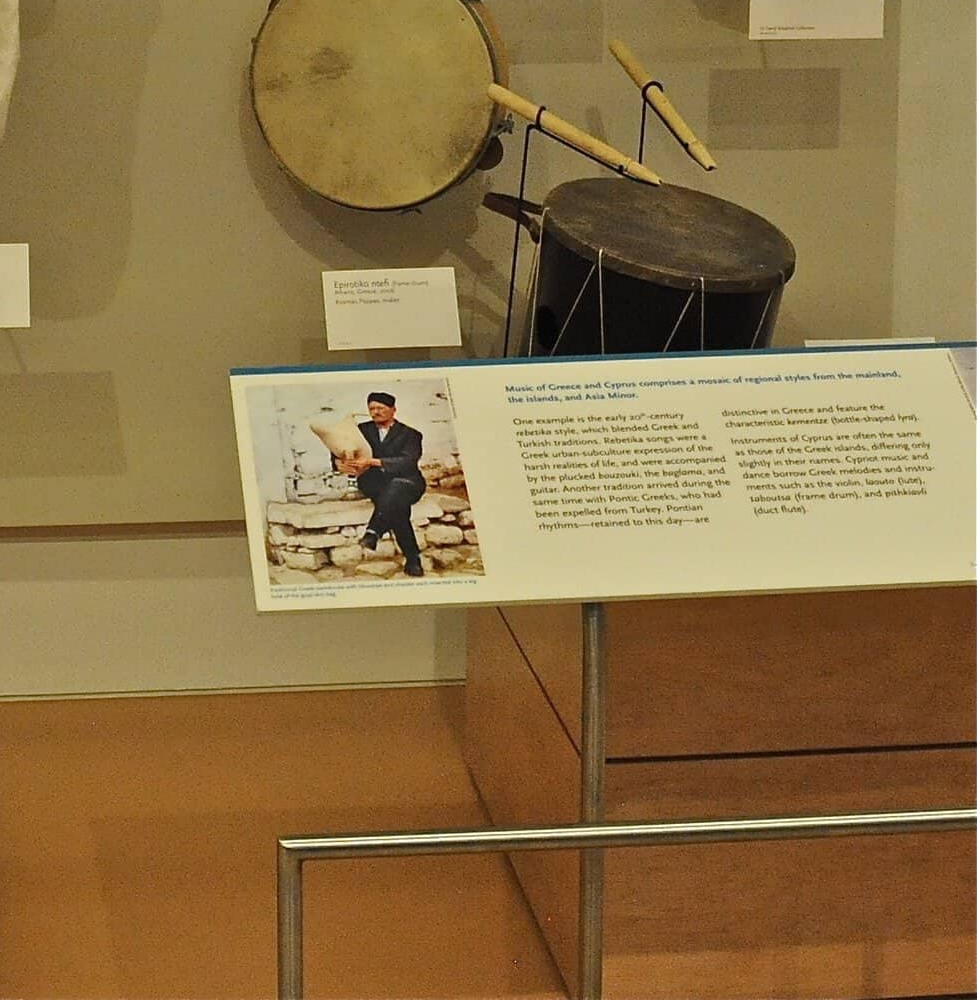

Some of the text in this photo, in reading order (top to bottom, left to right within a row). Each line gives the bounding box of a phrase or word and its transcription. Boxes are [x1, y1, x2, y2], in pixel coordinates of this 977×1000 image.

[505, 384, 533, 392] Music
[536, 383, 545, 391] of
[584, 381, 601, 389] and
[603, 381, 636, 390] Cyprus
[638, 379, 686, 389] comprises
[697, 377, 730, 385] mosaic
[733, 376, 742, 384] of
[744, 375, 782, 385] regional
[784, 374, 810, 384] styles
[812, 373, 835, 381] from
[837, 372, 852, 380] the
[507, 395, 523, 403] the
[565, 393, 582, 401] and
[585, 392, 605, 400] Asia
[721, 408, 767, 416] distinctive
[781, 406, 814, 414] Greece
[835, 404, 867, 412] feature
[516, 428, 551, 436] rebetika
[581, 425, 608, 433] which
[610, 424, 649, 432] blended
[651, 423, 679, 431] Greek
[682, 422, 699, 430] and
[516, 440, 551, 448] Turkish
[603, 436, 643, 444] Rebetika
[730, 435, 787, 444] Instruments
[789, 434, 799, 442] of
[801, 434, 833, 443] Cyprus
[852, 432, 877, 440] often
[878, 431, 893, 439] the
[521, 450, 549, 458] Greek
[552, 448, 631, 457] urban-subculture
[633, 446, 683, 456] expression
[697, 444, 713, 452] the
[747, 447, 773, 455] those
[786, 446, 801, 454] the
[804, 445, 831, 453] Greek
[871, 442, 910, 452] differing
[911, 441, 930, 451] only
[523, 462, 550, 470] harsh
[553, 461, 588, 469] realities
[590, 460, 599, 468] of
[665, 456, 726, 466] accompanied
[738, 458, 770, 469] slightly
[773, 458, 783, 466] in
[784, 457, 805, 465] their
[845, 454, 878, 465] Cypriot
[911, 452, 929, 460] and
[526, 474, 537, 484] by
[540, 473, 555, 481] the
[558, 472, 595, 482] plucked
[644, 469, 659, 477] the
[742, 464, 934, 478] dance borrow Greek melodies and instru-
[562, 484, 600, 492] Another
[603, 482, 643, 490] tradition
[647, 481, 679, 489] arrived
[681, 479, 713, 490] during
[561, 496, 583, 504] time
[585, 495, 606, 503] with
[609, 494, 639, 502] Pontic
[680, 491, 701, 499] who
[702, 490, 721, 498] had
[535, 510, 559, 518] been
[562, 508, 601, 518] expelled
[604, 507, 627, 515] from
[666, 504, 703, 512] Pontian
